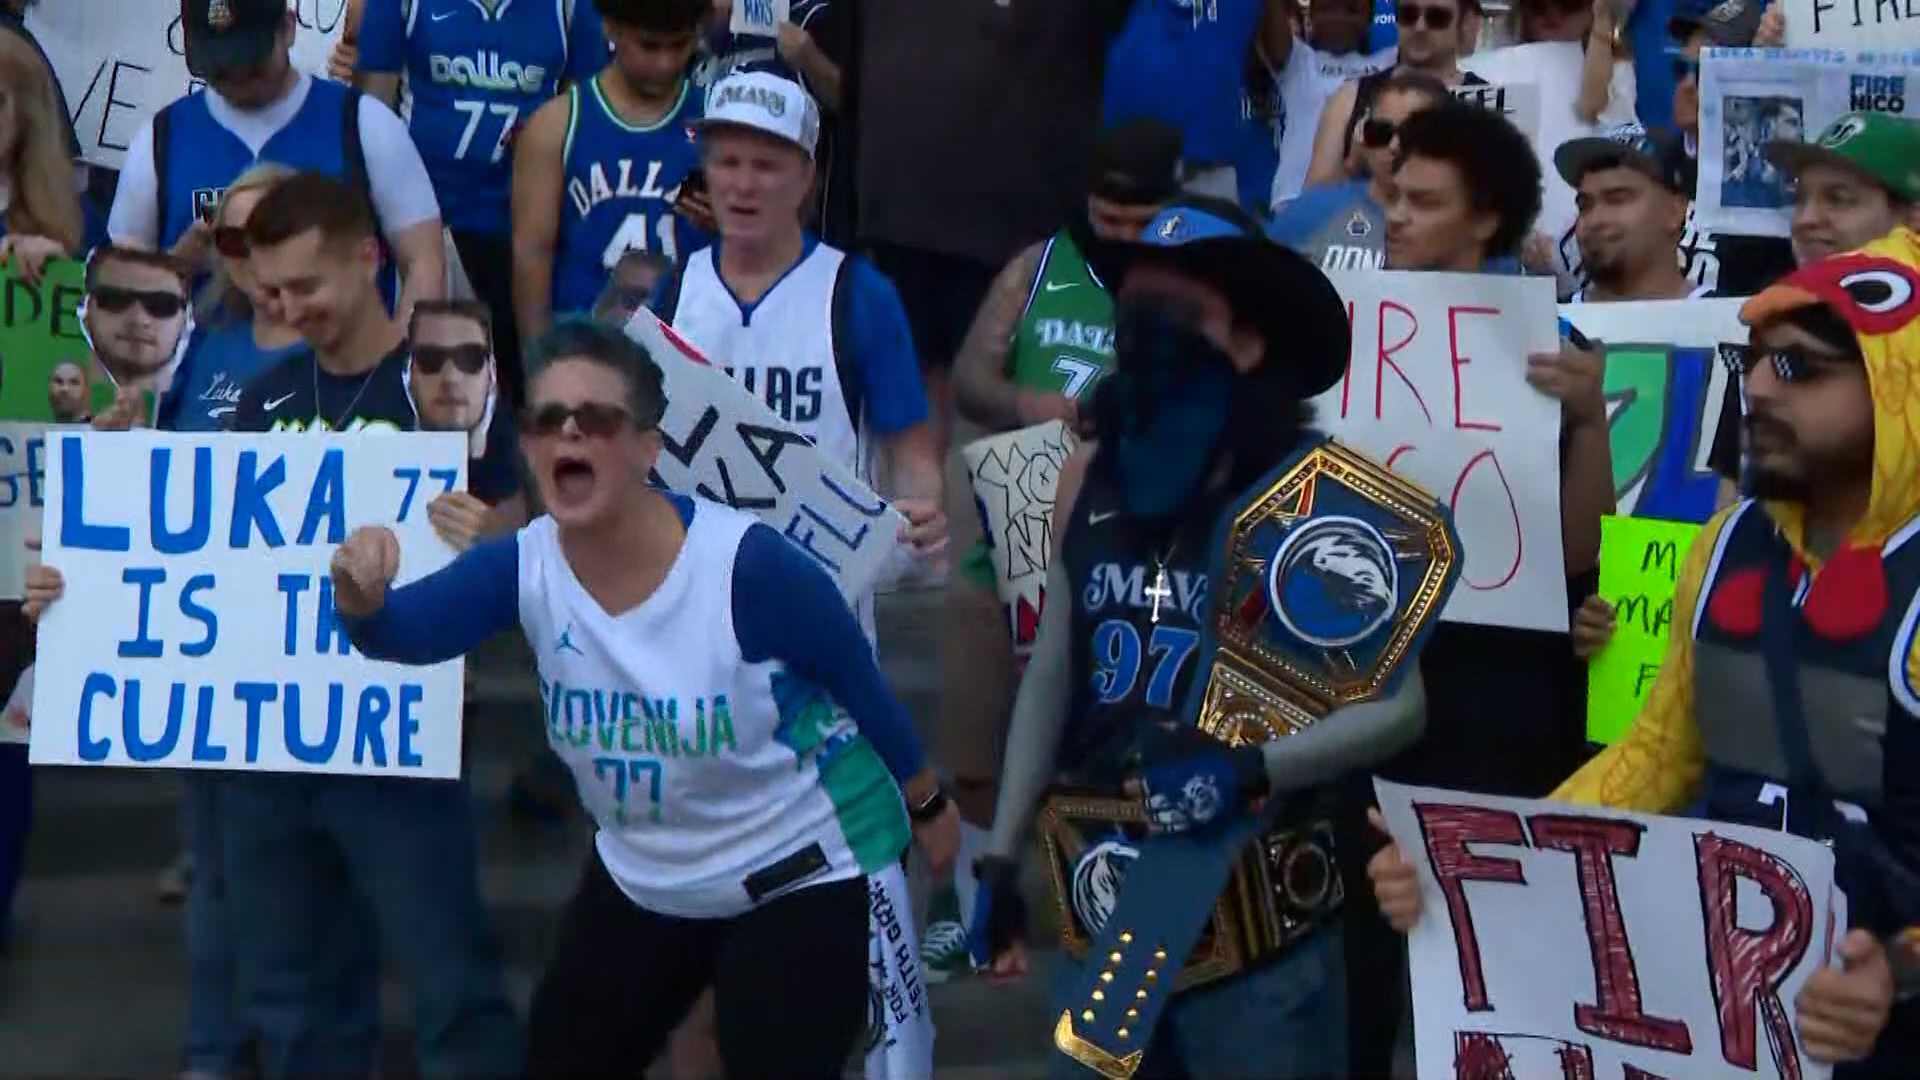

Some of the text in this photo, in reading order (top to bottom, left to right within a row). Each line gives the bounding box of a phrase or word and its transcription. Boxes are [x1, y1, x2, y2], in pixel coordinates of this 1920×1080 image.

[1851, 74, 1906, 95] FIRE
[1851, 95, 1905, 113] NICO
[453, 99, 519, 163] 77
[1340, 300, 1503, 430] IRE
[61, 436, 346, 554] LUKA
[117, 567, 219, 658] IS
[276, 573, 352, 657] TH
[1090, 618, 1200, 708] 97
[77, 672, 424, 768] CULTURE
[592, 756, 662, 825] 77
[1411, 800, 1835, 1080] FIR
